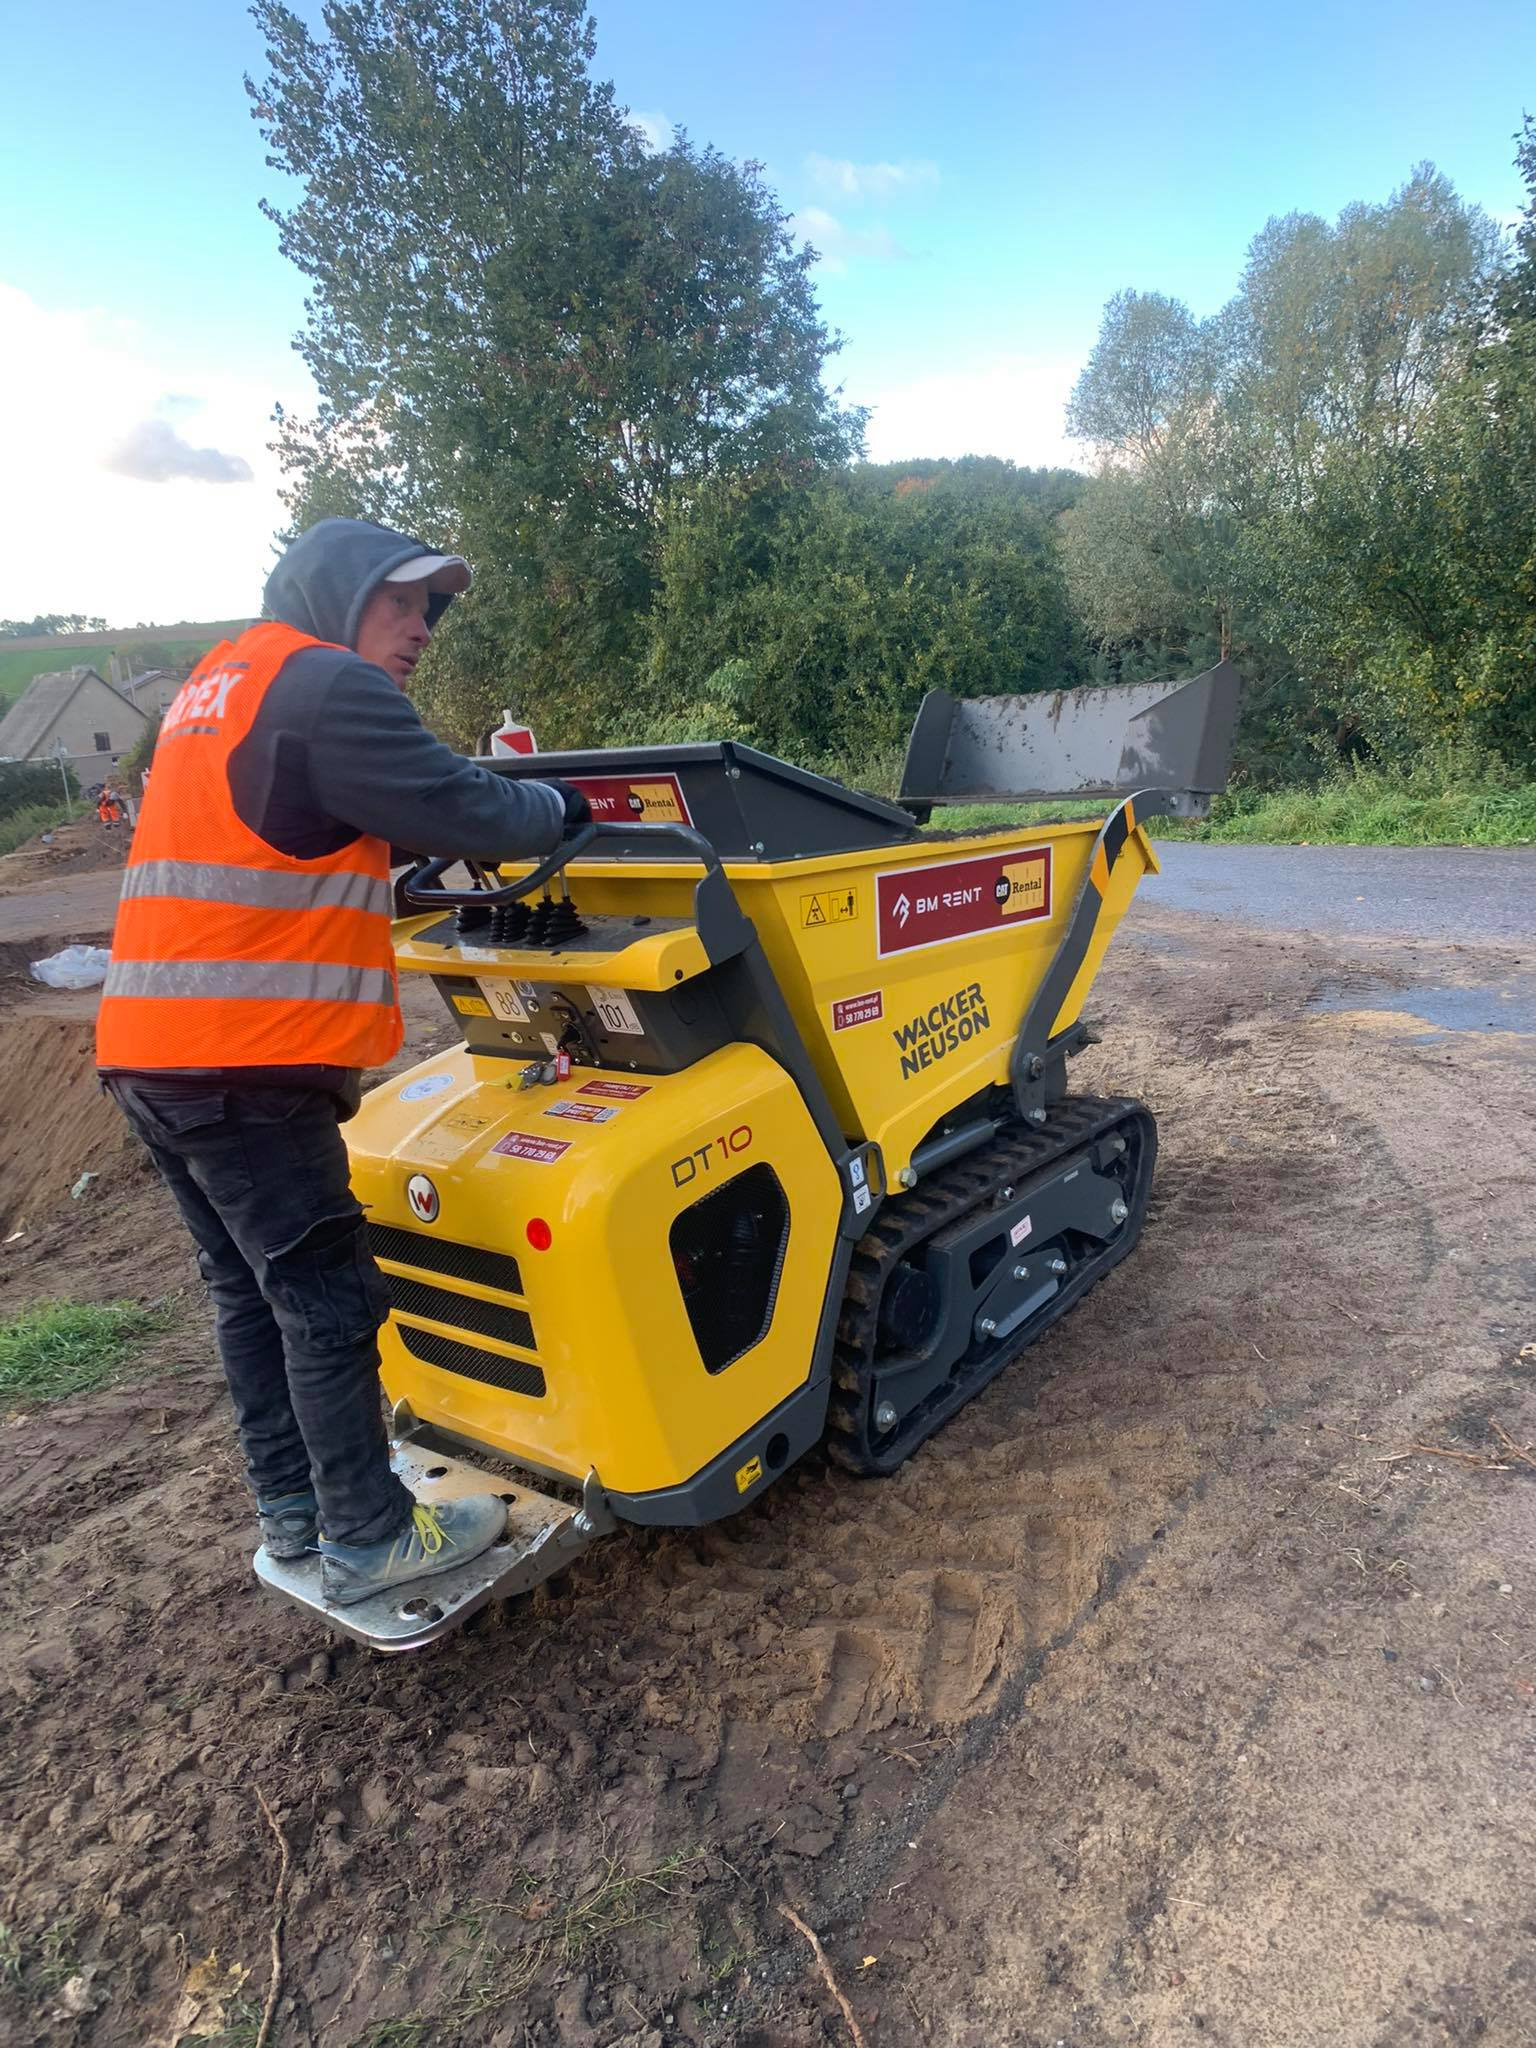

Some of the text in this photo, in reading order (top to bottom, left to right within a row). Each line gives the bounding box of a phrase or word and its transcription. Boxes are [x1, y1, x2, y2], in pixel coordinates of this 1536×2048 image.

[588, 798, 615, 810] ENT
[644, 798, 676, 808] Rental
[916, 887, 982, 914] BM RENT
[995, 878, 1042, 898] CAT Rental
[496, 991, 520, 1016] 88
[600, 1004, 629, 1029] 101
[893, 982, 985, 1052] WACKER
[900, 1005, 990, 1080] NEUSON
